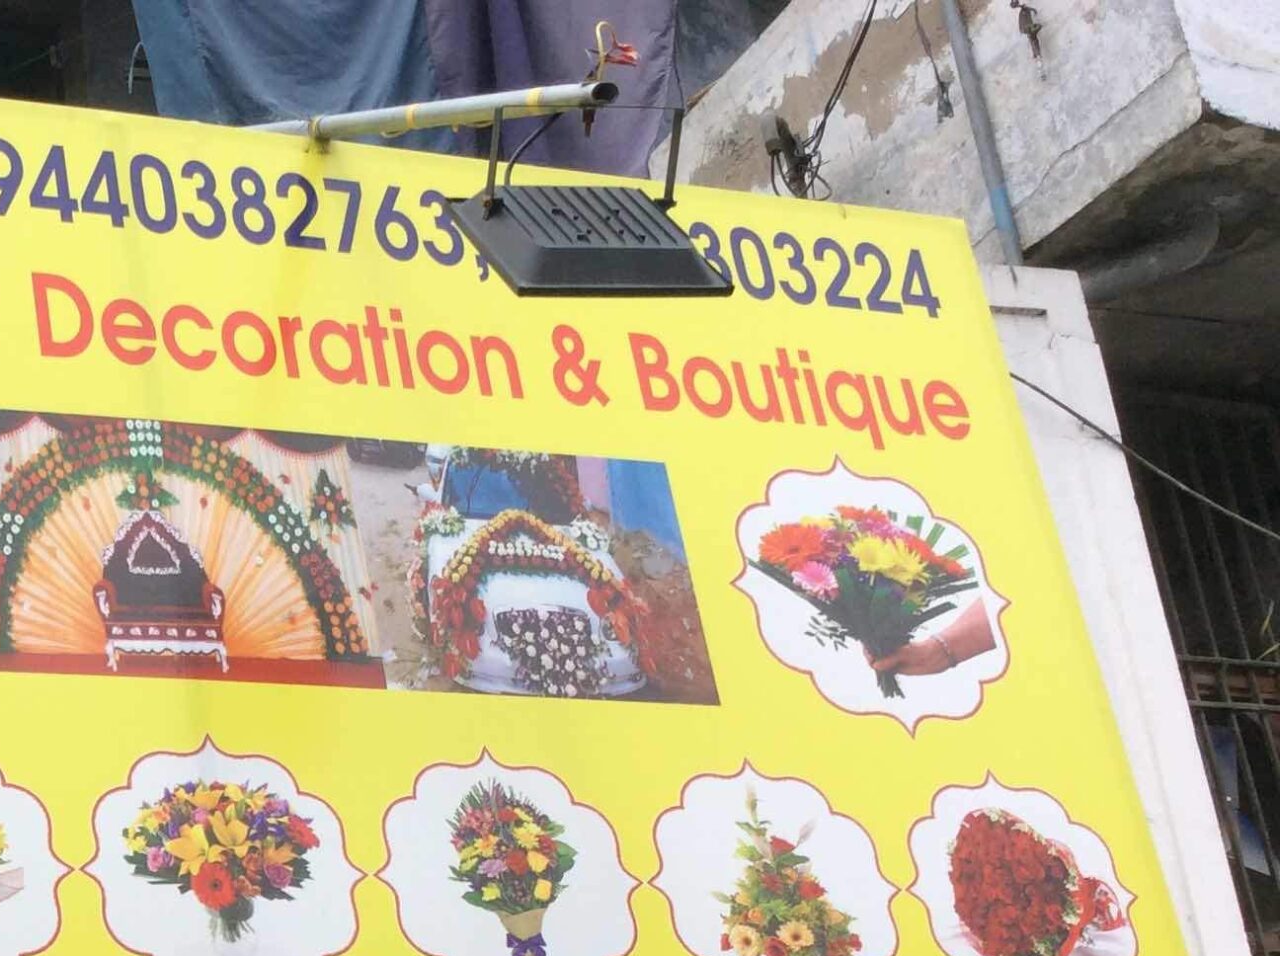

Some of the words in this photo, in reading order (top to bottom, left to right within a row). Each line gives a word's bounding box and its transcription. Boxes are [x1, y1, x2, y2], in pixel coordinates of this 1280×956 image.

[31, 271, 525, 399] Decoration
[551, 324, 610, 406] &
[628, 332, 971, 450] Boutique
